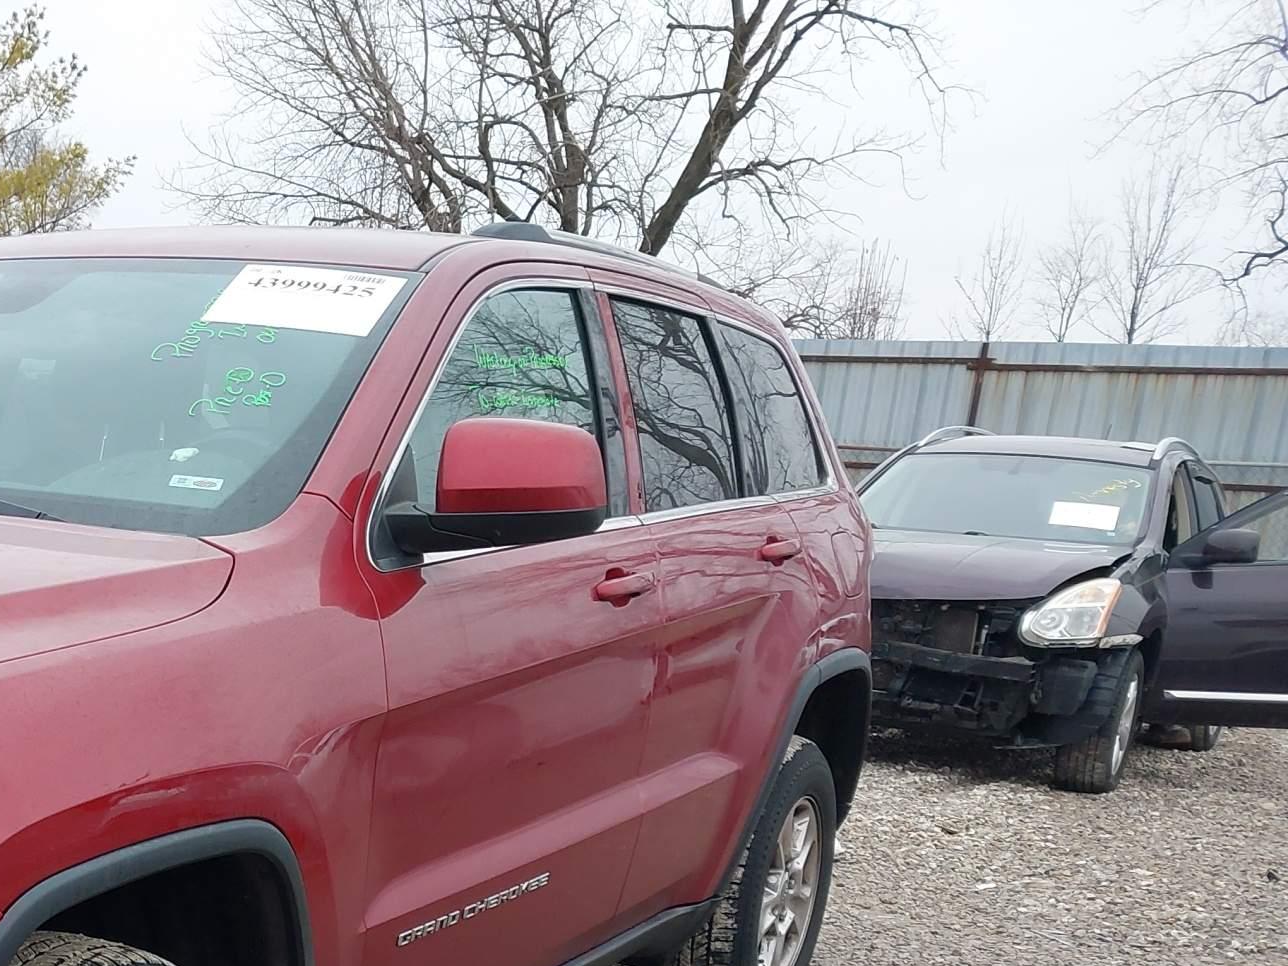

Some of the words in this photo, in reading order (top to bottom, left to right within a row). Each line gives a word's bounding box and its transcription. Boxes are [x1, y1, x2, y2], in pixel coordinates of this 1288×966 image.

[247, 276, 377, 299] 43999425
[397, 910, 461, 947] GRAND
[462, 872, 551, 919] CHEROKEE
